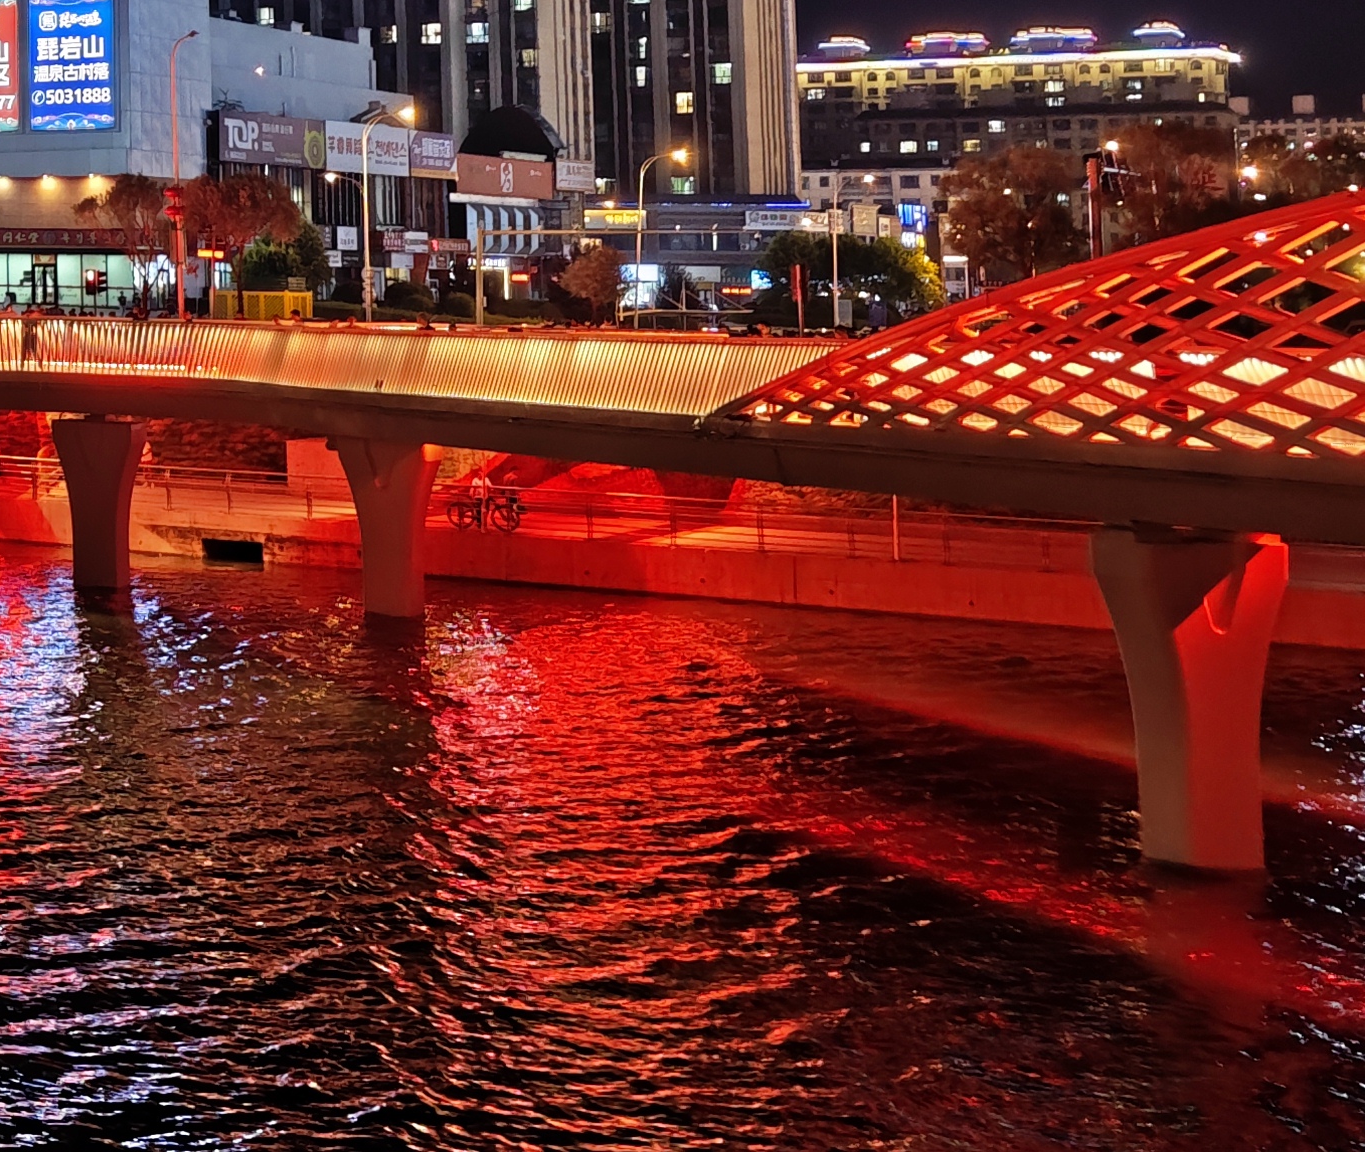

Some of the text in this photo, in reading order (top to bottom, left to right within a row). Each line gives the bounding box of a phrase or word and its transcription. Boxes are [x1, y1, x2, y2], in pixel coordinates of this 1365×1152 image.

[36, 34, 105, 62] 琵岩山
[33, 62, 110, 84] 温泉古村落
[45, 87, 112, 105] 5031888
